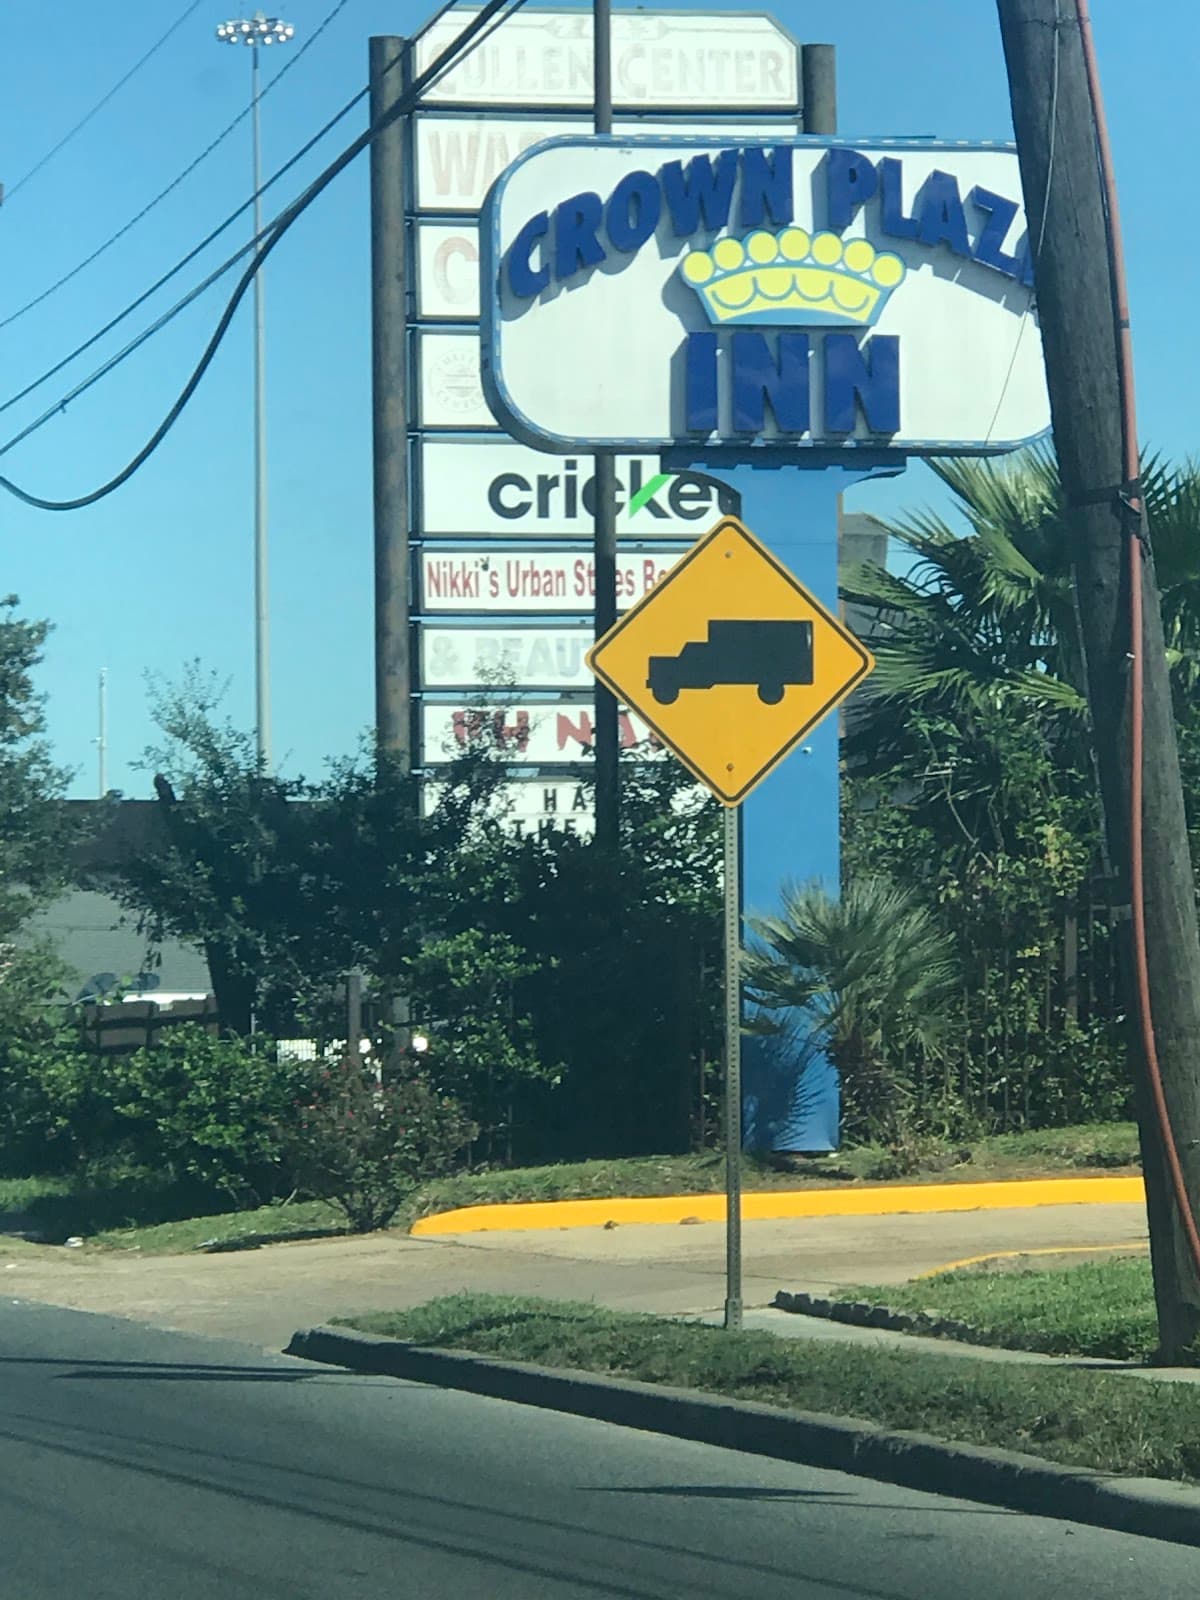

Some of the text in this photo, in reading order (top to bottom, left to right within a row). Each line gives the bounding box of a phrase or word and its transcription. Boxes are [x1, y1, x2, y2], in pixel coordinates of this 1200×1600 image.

[429, 42, 786, 98] CULLEN CENTER
[506, 146, 1034, 298] CROWN PLAZ
[686, 331, 901, 433] INN
[487, 458, 724, 521] cricke
[506, 559, 566, 597] Urban
[573, 558, 635, 597] Stes
